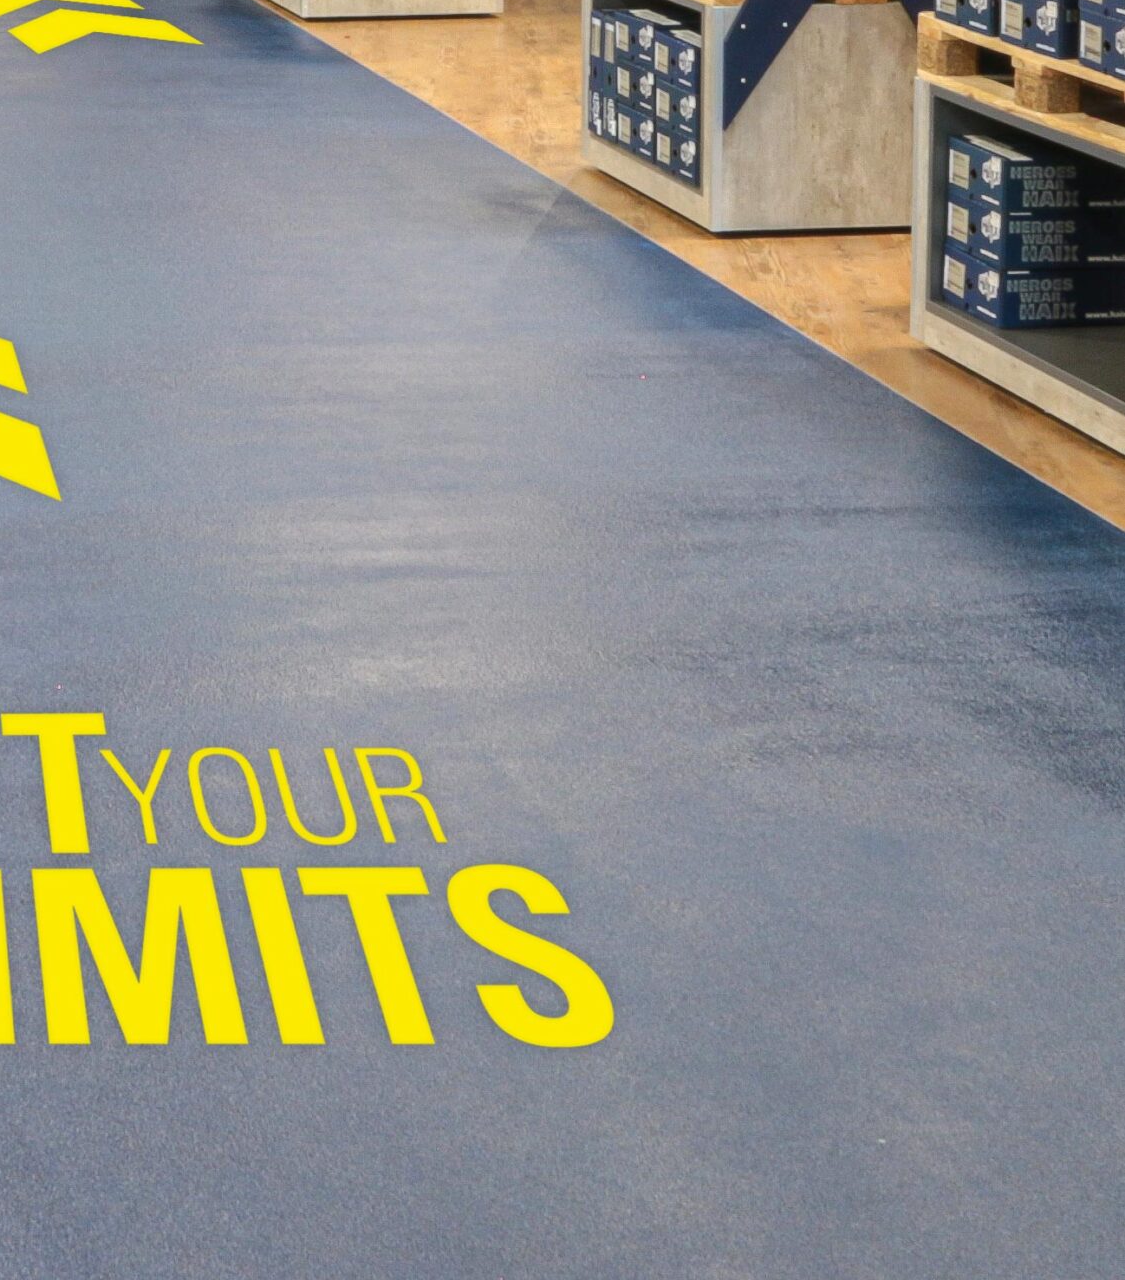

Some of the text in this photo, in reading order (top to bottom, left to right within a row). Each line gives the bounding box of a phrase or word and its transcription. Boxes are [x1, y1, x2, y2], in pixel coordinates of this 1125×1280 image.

[1010, 166, 1076, 179] HEROES
[1023, 180, 1065, 190] WEAR
[1022, 190, 1079, 207] HAIX
[1009, 221, 1075, 234] HEROES
[1022, 234, 1064, 245] WEAR
[1021, 245, 1079, 262] HAIX
[1006, 279, 1073, 293] HEROES
[1019, 292, 1061, 302] WEAR
[1019, 302, 1076, 320] HAIX
[101, 747, 448, 846] YOUR
